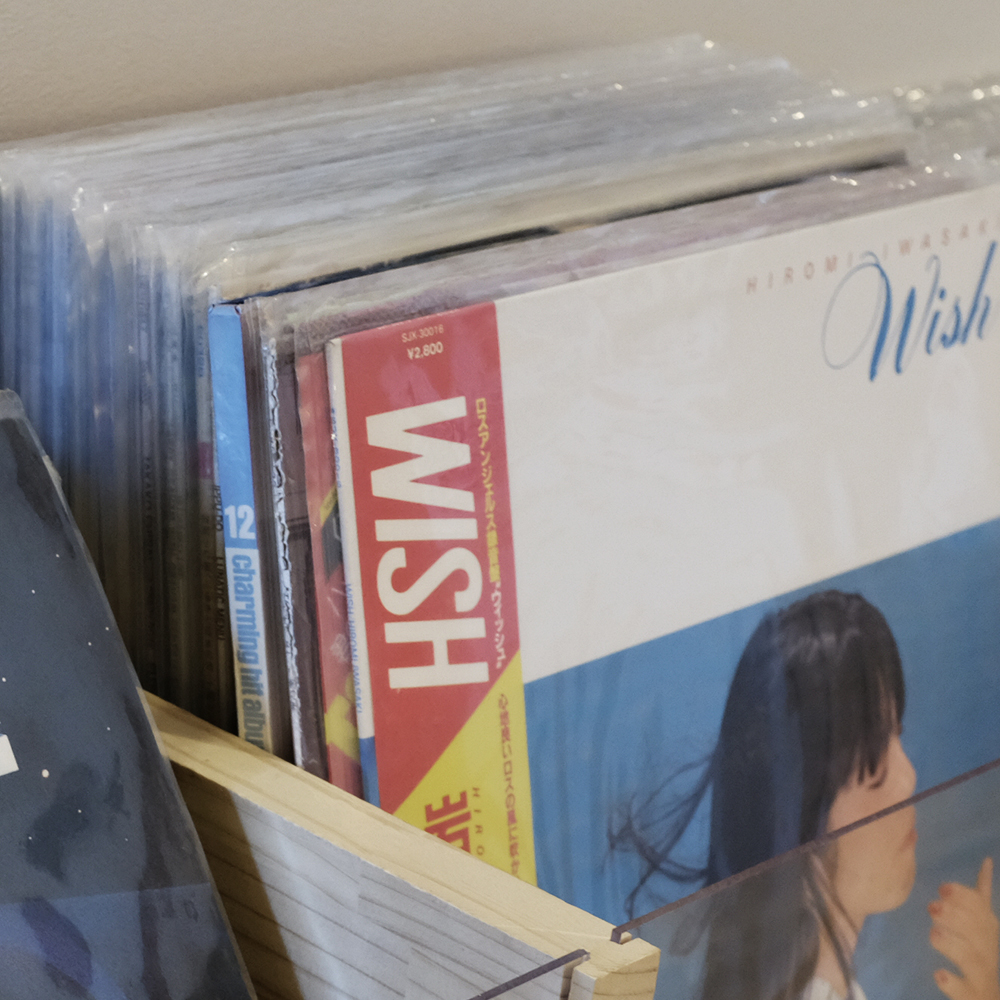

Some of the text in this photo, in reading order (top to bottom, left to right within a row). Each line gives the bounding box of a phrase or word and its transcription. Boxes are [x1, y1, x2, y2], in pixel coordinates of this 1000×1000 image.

[821, 240, 998, 382] Wish
[407, 341, 444, 360] ¥2,800
[223, 504, 257, 540] 12
[366, 396, 490, 690] WISH
[231, 554, 262, 665] charming
[240, 664, 265, 697] hit
